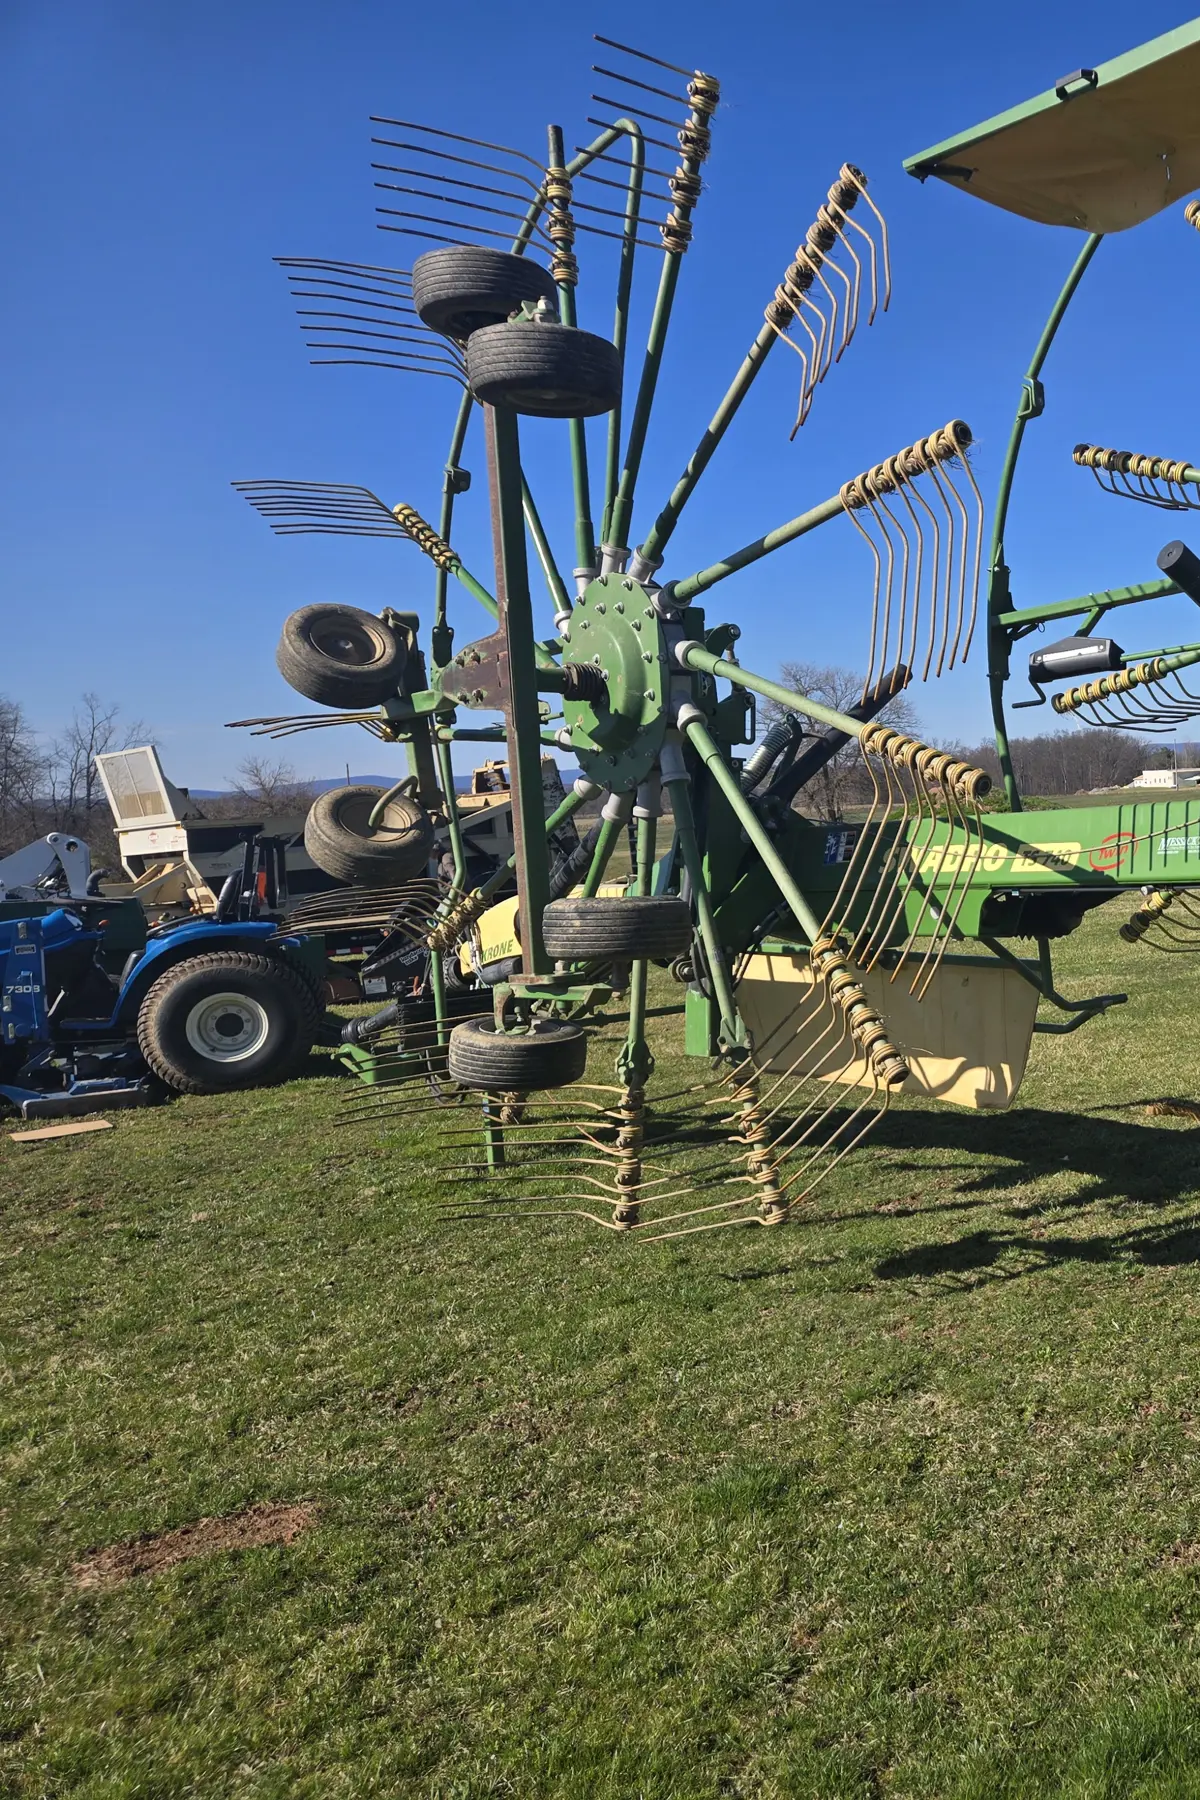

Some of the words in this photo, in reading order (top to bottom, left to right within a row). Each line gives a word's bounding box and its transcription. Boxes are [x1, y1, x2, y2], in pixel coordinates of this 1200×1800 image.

[1021, 849, 1039, 866] TS
[1042, 848, 1071, 866] 740
[481, 939, 513, 963] KRONE
